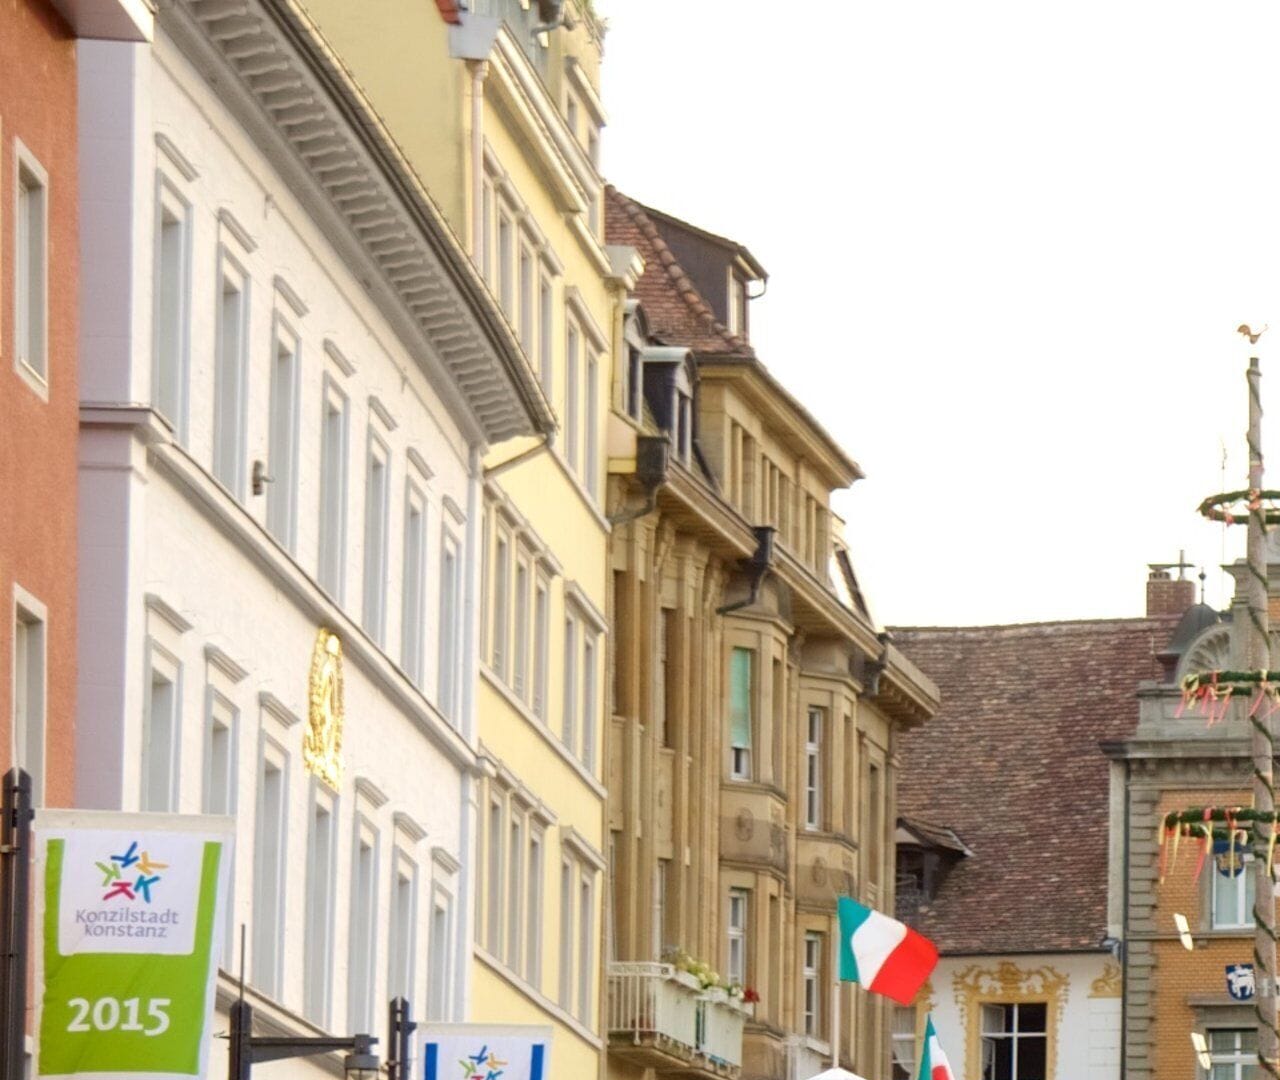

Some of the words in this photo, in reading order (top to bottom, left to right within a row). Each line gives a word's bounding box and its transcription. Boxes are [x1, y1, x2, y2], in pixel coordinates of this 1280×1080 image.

[75, 907, 180, 924] Konzilstadt
[84, 922, 168, 938] Konstanz
[66, 996, 172, 1036] 2015
